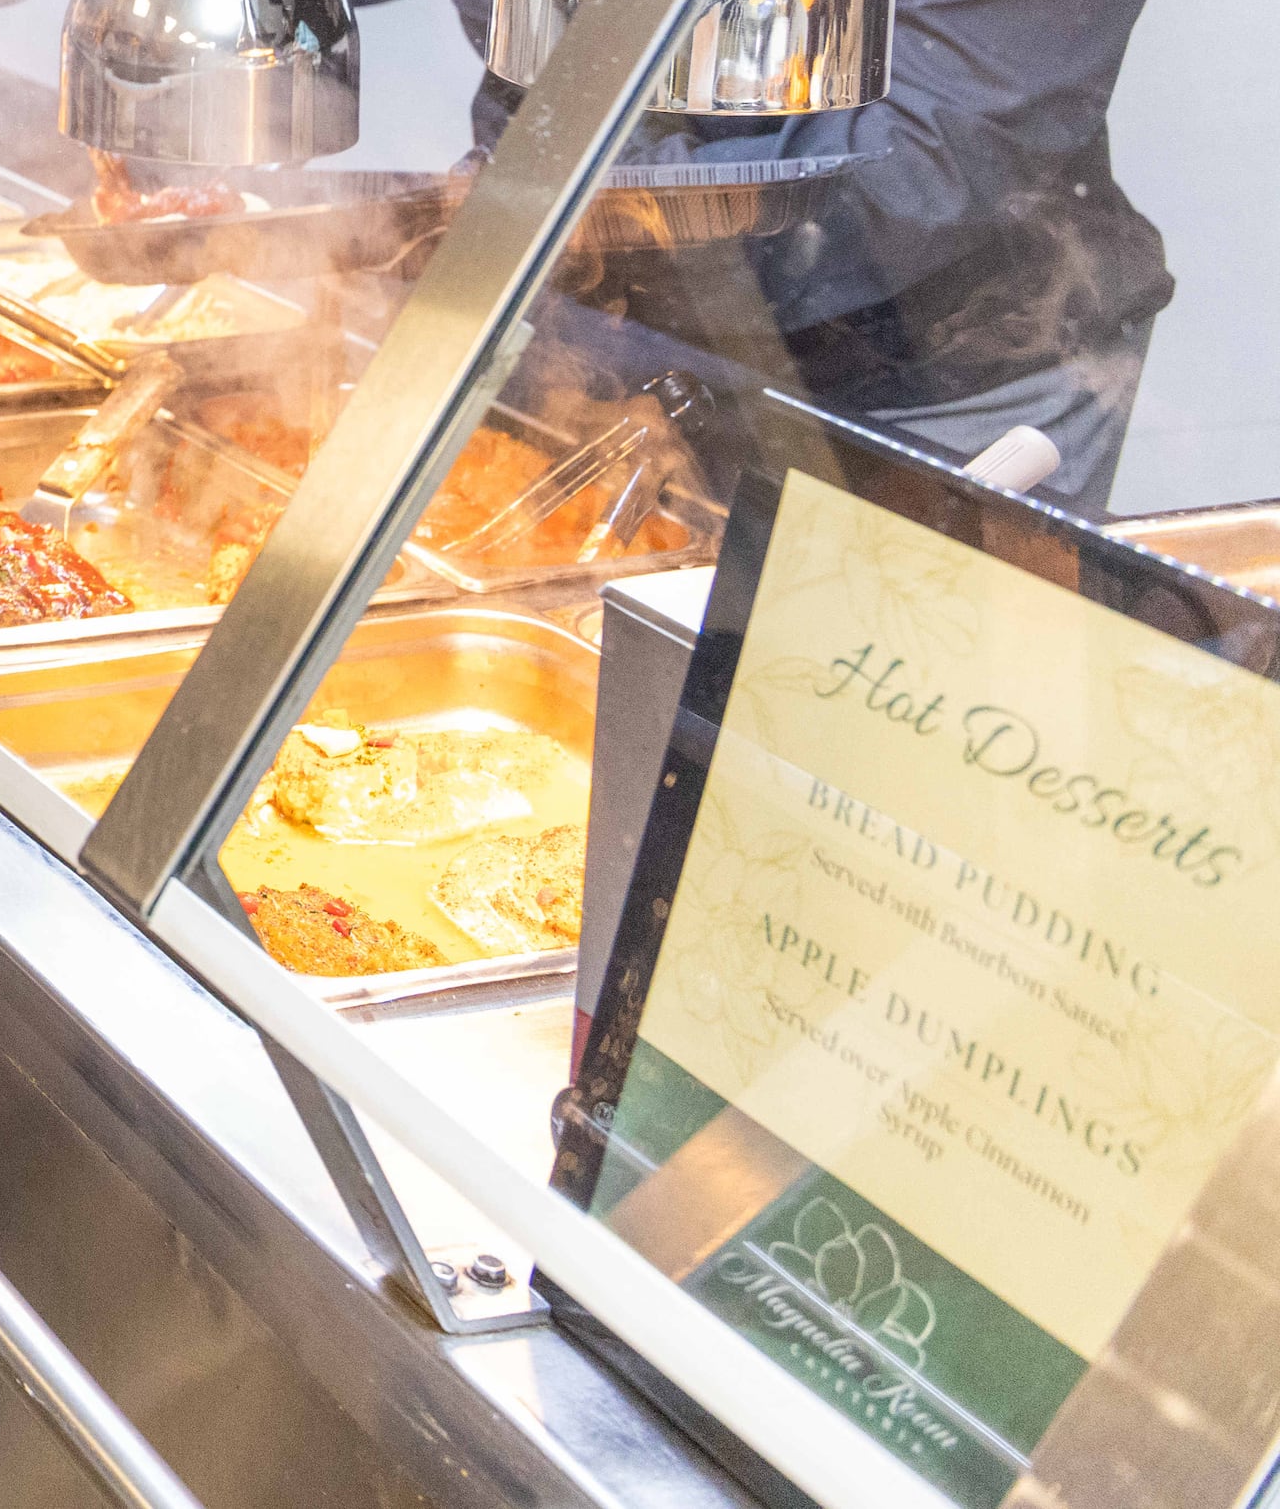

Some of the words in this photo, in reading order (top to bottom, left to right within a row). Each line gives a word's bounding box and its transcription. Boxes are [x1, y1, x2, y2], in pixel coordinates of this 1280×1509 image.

[814, 643, 946, 738] Hot
[961, 705, 1244, 889] Desserts
[806, 779, 940, 872] BREAD
[955, 861, 1162, 998] PUDDING
[811, 848, 886, 907] Served
[889, 893, 938, 935] with
[940, 920, 1049, 1000] Bourbon
[1051, 985, 1130, 1046] Sauce
[757, 912, 872, 1003] APPLE
[885, 992, 1146, 1177] DUMPLINGS
[762, 994, 839, 1053] Served
[840, 1048, 892, 1087] over
[898, 1080, 961, 1136] Apple
[965, 1122, 1092, 1226] Cinnamon
[877, 1104, 945, 1164] Syrup
[718, 1251, 868, 1374] Magnolia
[861, 1372, 960, 1451] Room
